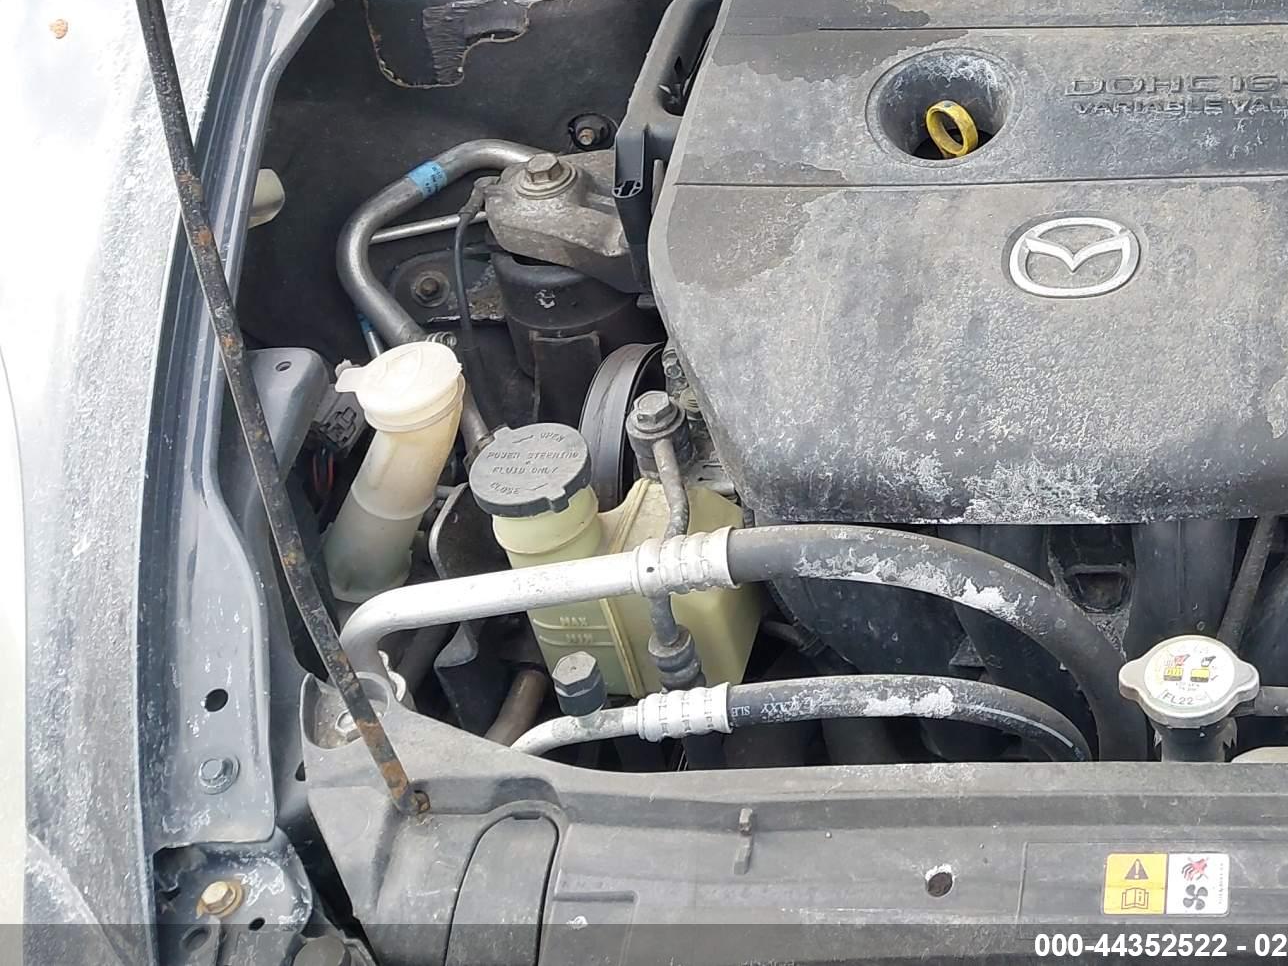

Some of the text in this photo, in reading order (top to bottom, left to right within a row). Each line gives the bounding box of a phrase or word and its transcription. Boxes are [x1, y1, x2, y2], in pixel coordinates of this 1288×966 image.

[1064, 73, 1220, 97] DOHC
[1075, 96, 1224, 116] VARIABLE
[540, 431, 566, 443] OPEN
[487, 451, 580, 459] POWER STEERING
[492, 466, 560, 475] FLUID ONLY
[489, 481, 521, 495] CLOSE
[559, 616, 592, 627] MAX
[1161, 691, 1194, 706] FL22
